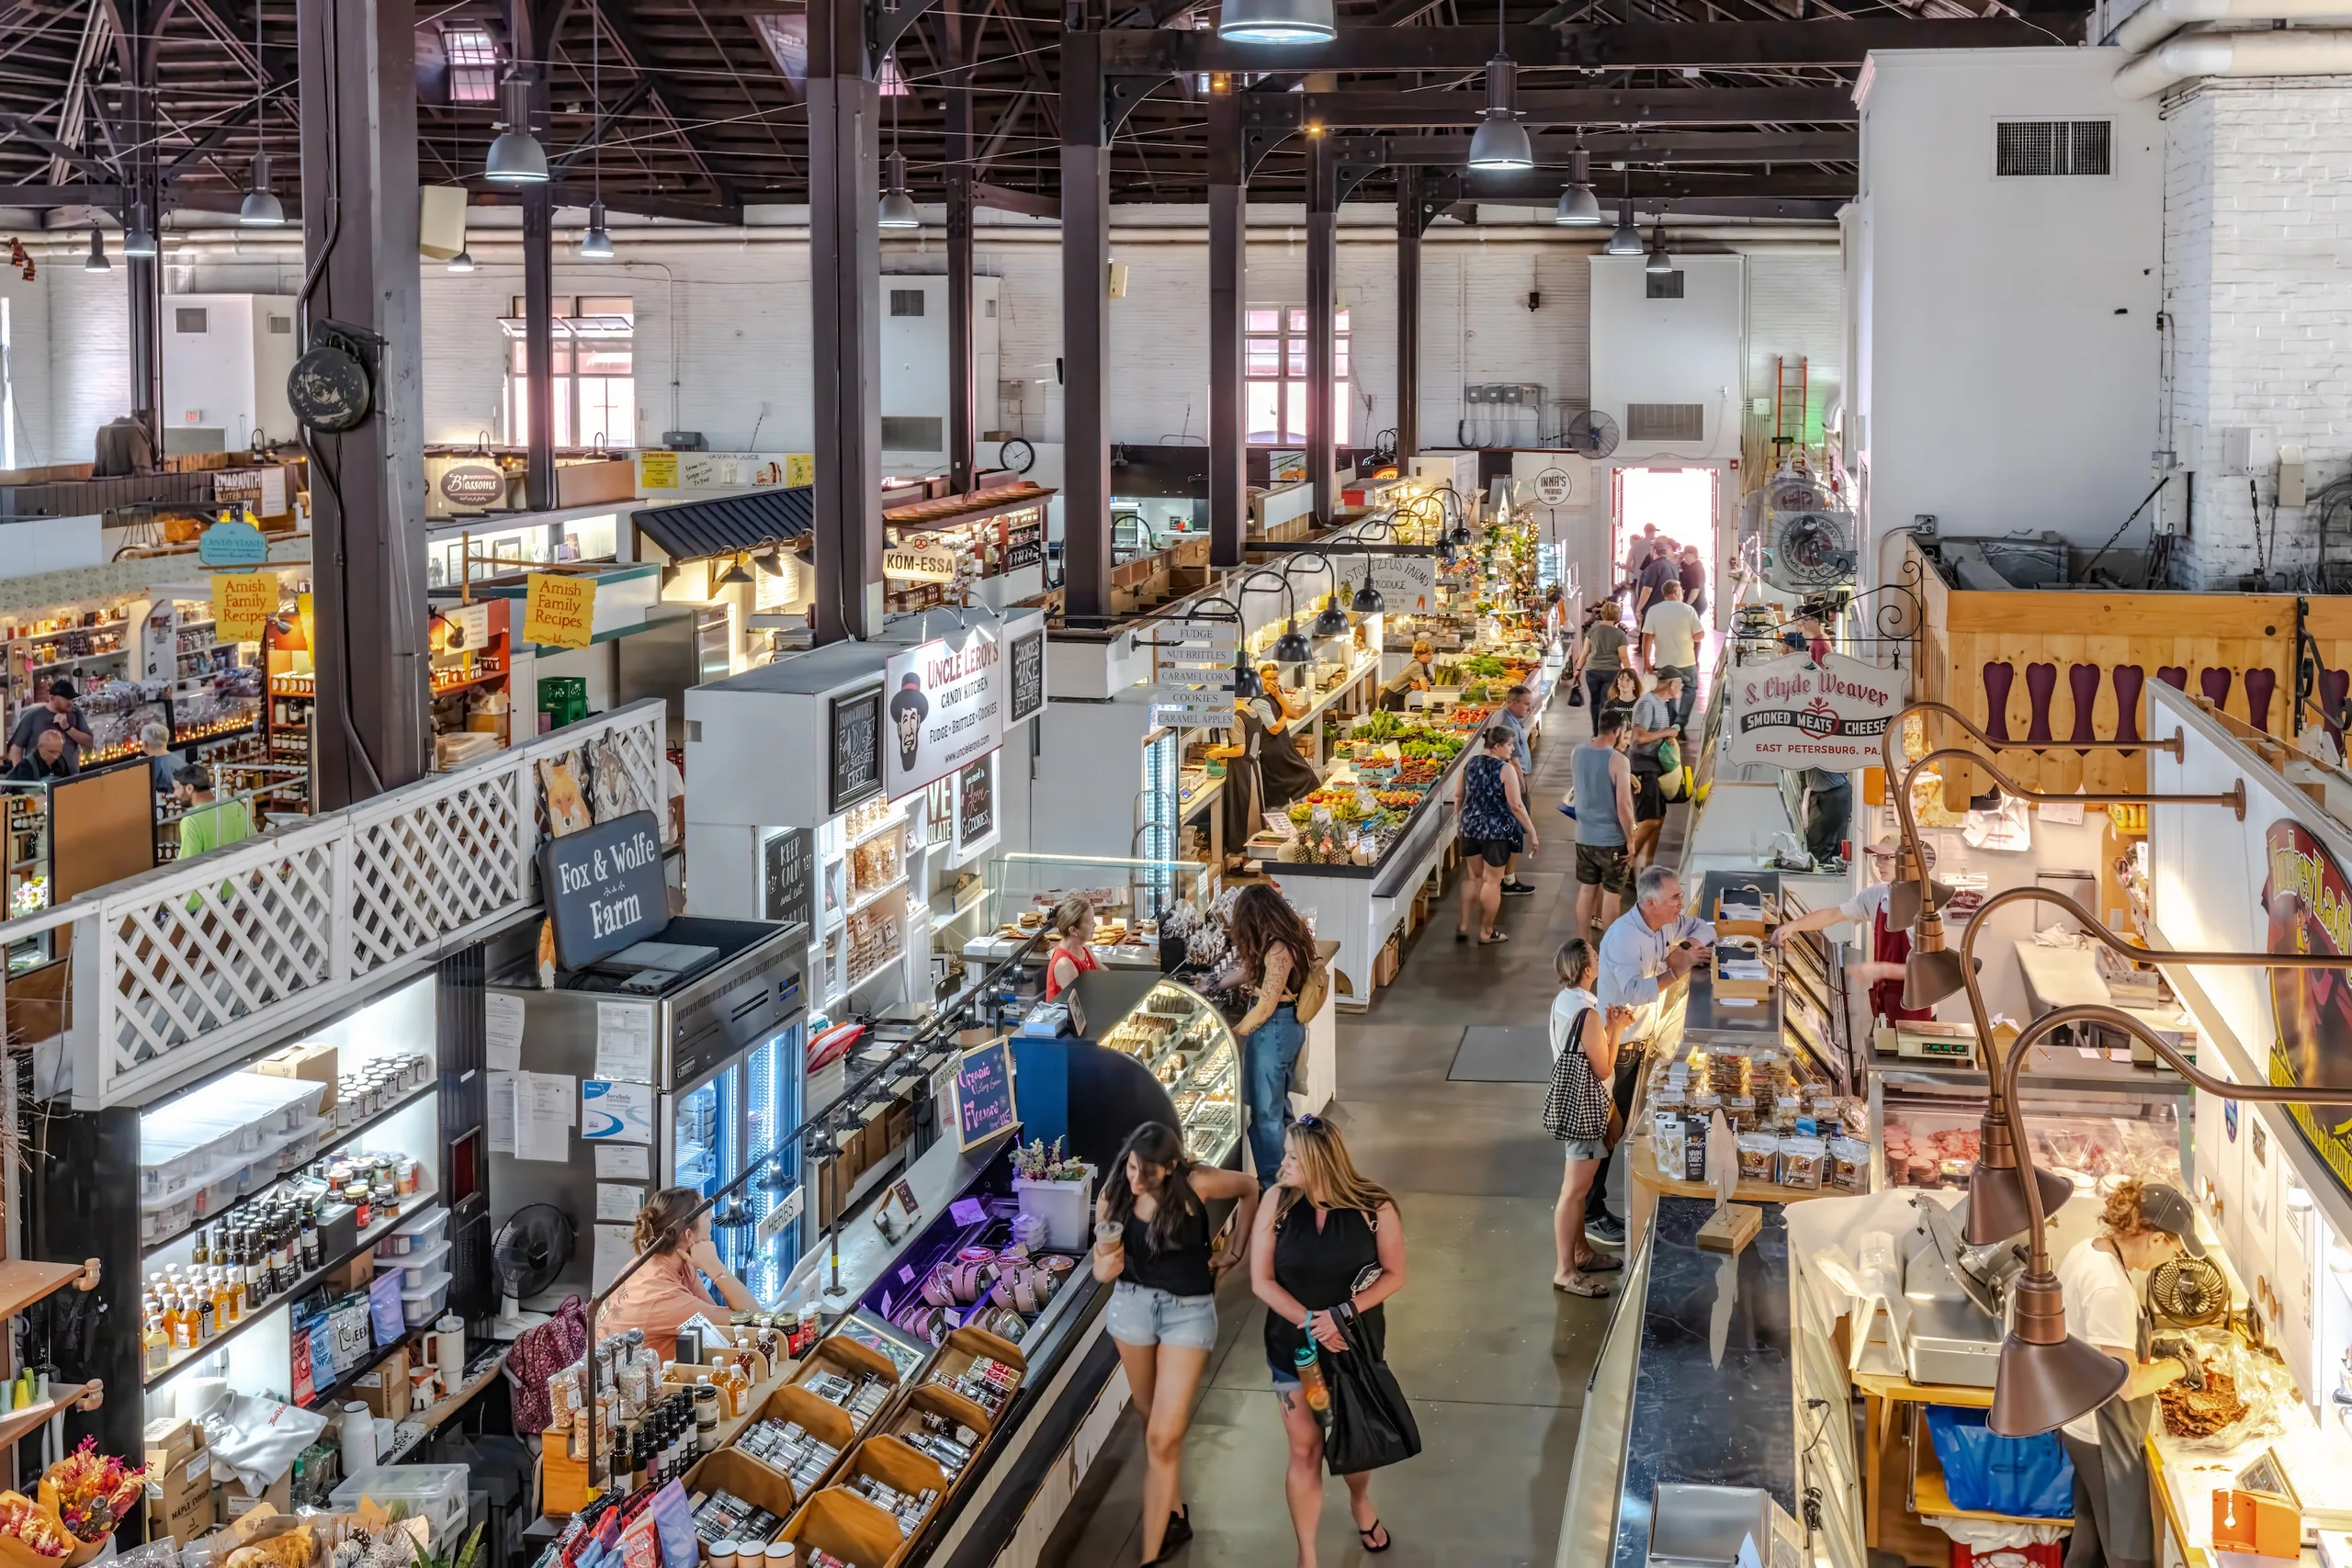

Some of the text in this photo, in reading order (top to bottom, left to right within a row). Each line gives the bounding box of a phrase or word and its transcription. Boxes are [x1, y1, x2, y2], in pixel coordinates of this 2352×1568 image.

[447, 473, 496, 492] Blossoms
[1541, 476, 1566, 487] INNA'S
[243, 490, 262, 499] FREE
[204, 538, 265, 548] CANDY STAND
[887, 551, 953, 573] KÖM-ESSA
[1345, 558, 1431, 587] STOLTZFUS FARMS
[224, 579, 266, 593] Amish
[539, 580, 582, 597] Amish
[225, 593, 267, 611] Family
[537, 593, 582, 615] Family
[223, 608, 269, 626] Recipes
[535, 608, 582, 629] Recipes
[1180, 629, 1213, 638] FUDGE
[928, 640, 999, 690] UNCLE LEROY'S
[1167, 650, 1227, 660] NUT BRITTLES
[1015, 656, 1040, 686] MAKE
[1161, 671, 1229, 682] CARAMEL CORN
[941, 675, 989, 708] CANDY KITCHEN
[1172, 694, 1218, 703] COOKIES
[1745, 672, 1889, 708] S. Clyde Weaver
[930, 702, 997, 744] FUDGE BRITTLES COOKIES
[1158, 714, 1233, 724] CARAMEL APPLES
[1747, 712, 1887, 735] SMOKED MEATS CHEESE
[944, 734, 990, 764] www.uncleleroys.com
[1756, 743, 1782, 752] EAST
[1864, 747, 1881, 755] PA.
[847, 764, 867, 790] FREE!
[967, 784, 990, 818] Love
[967, 809, 989, 834] COOKIES
[780, 836, 800, 866] KEEP
[559, 831, 655, 895] Fox & Wolfe
[782, 857, 801, 888] CALM
[779, 887, 792, 907] and
[589, 894, 642, 940] Farm
[958, 1062, 990, 1095] Organic
[963, 1100, 999, 1132] Flowers
[767, 1198, 794, 1235] HERBS
[679, 1312, 706, 1332] RECIPES
[171, 1501, 191, 1521] MAPLE
